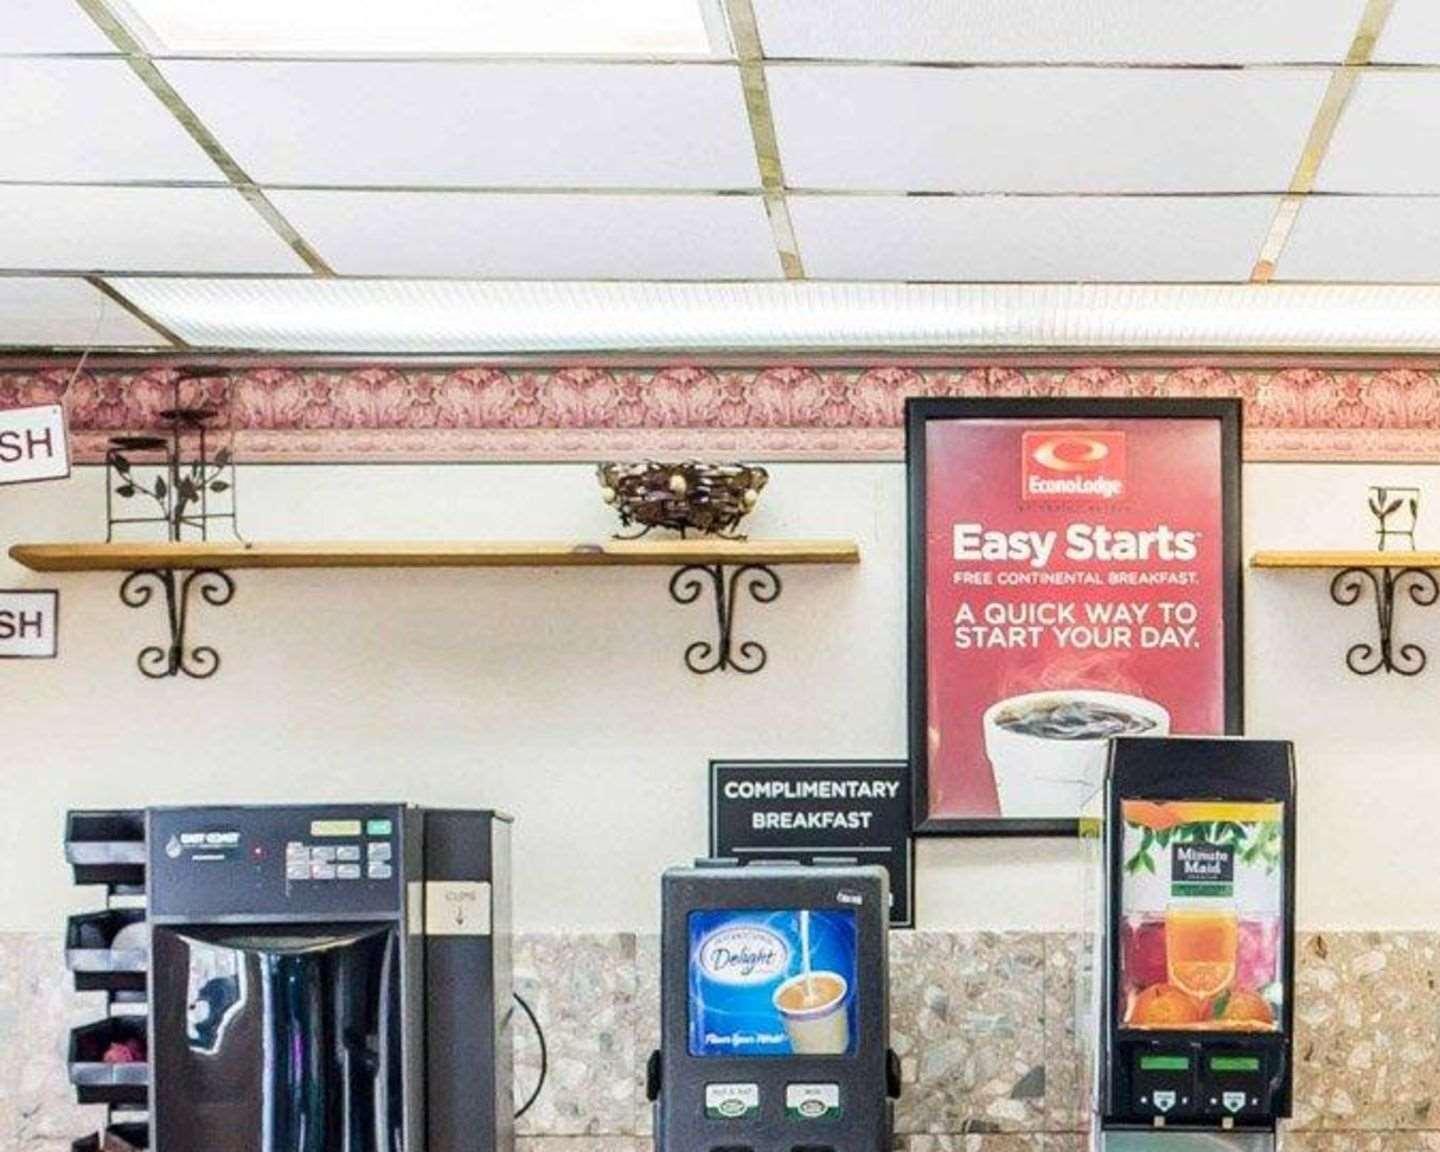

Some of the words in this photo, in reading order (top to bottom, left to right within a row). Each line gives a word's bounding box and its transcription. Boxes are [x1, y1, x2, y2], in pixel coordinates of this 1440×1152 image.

[1028, 474, 1122, 499] EconoLodge
[953, 524, 1056, 567] Easy
[1066, 524, 1197, 561] Starts
[953, 571, 993, 585] FREE
[998, 571, 1103, 585] CONTINENTAL
[1108, 571, 1199, 585] BREAKFAST.
[955, 603, 975, 625] A
[984, 603, 1075, 626] QUICK
[1085, 603, 1147, 625] WAY
[1158, 603, 1197, 625] TO
[955, 627, 1043, 648] START
[1052, 627, 1132, 648] YOUR
[1141, 627, 1200, 648] DAY.
[724, 781, 900, 799] COMPLIMENTARY
[752, 812, 873, 829] BREAKFAST
[1184, 861, 1222, 874] Maid
